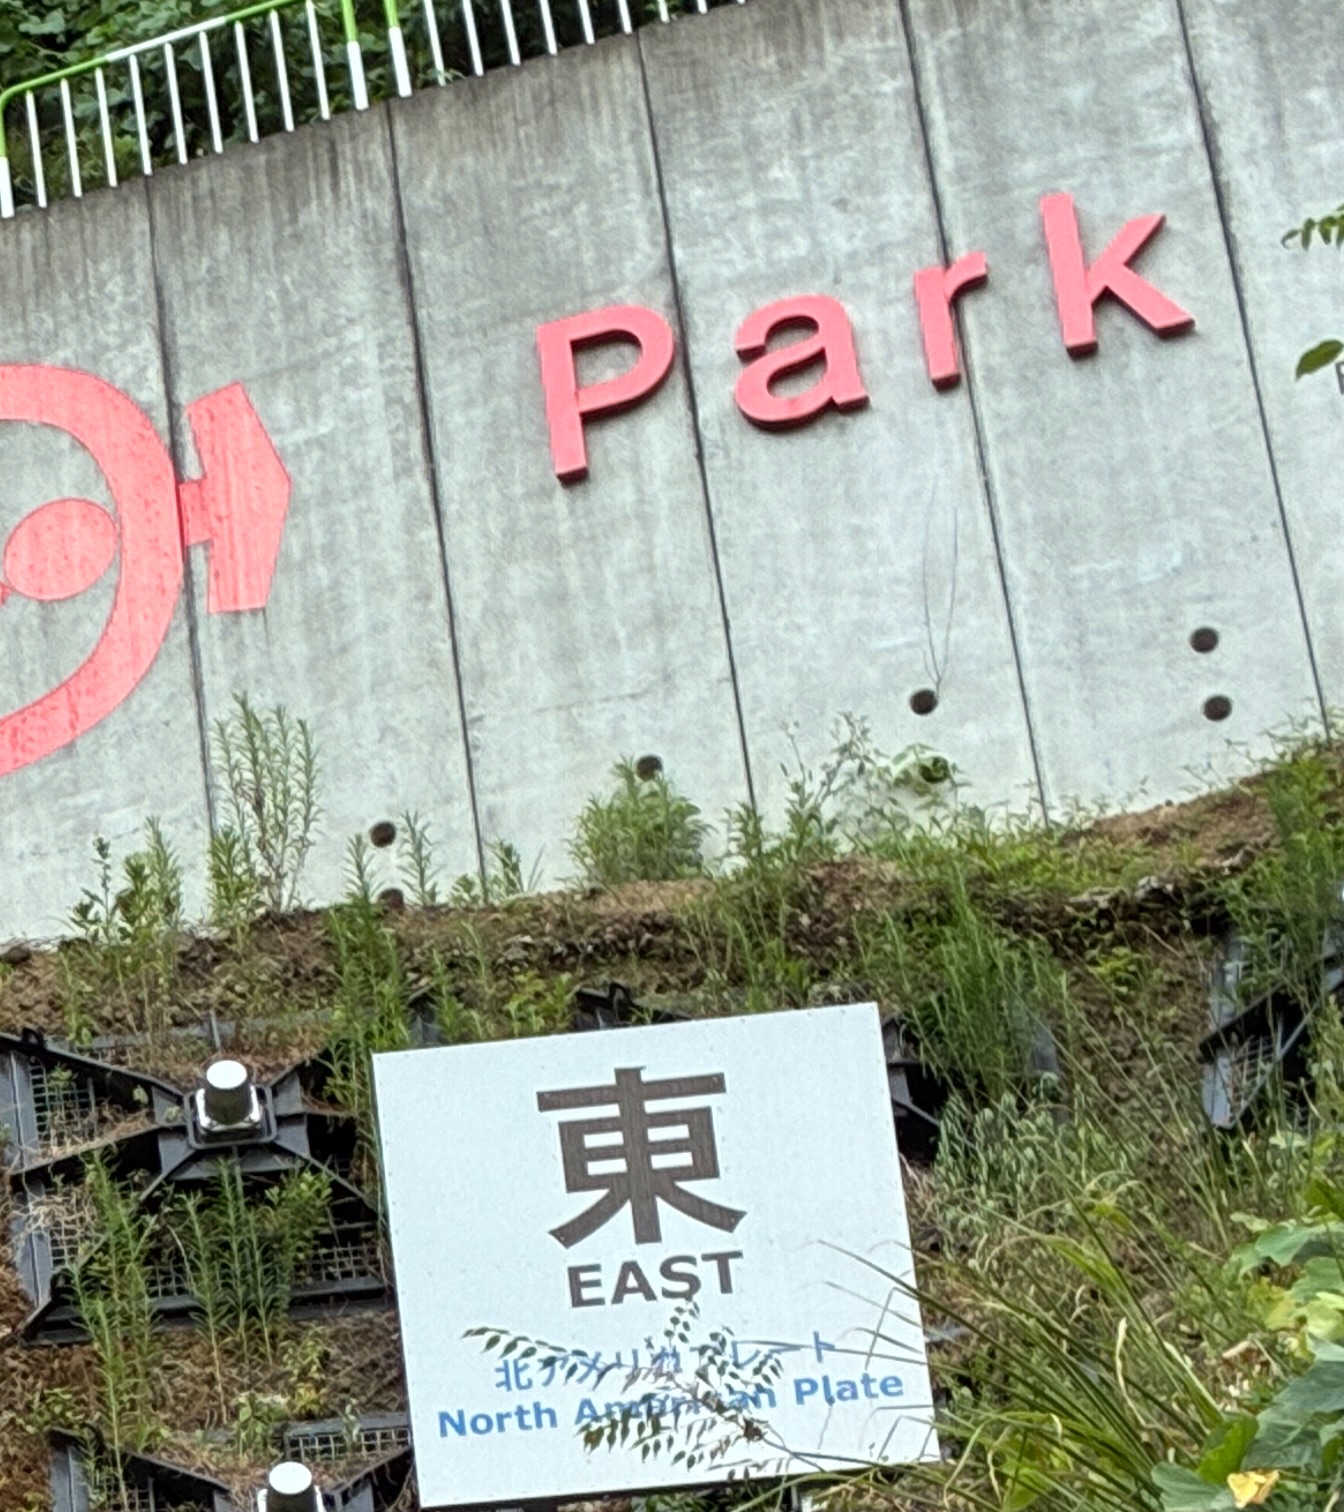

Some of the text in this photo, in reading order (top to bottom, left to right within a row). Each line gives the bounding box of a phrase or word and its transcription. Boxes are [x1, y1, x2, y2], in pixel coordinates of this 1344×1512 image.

[535, 192, 1197, 486] Park
[535, 1067, 748, 1250] 東
[566, 1249, 744, 1309] EAST
[437, 1400, 559, 1438] North
[793, 1372, 905, 1406] Plate
